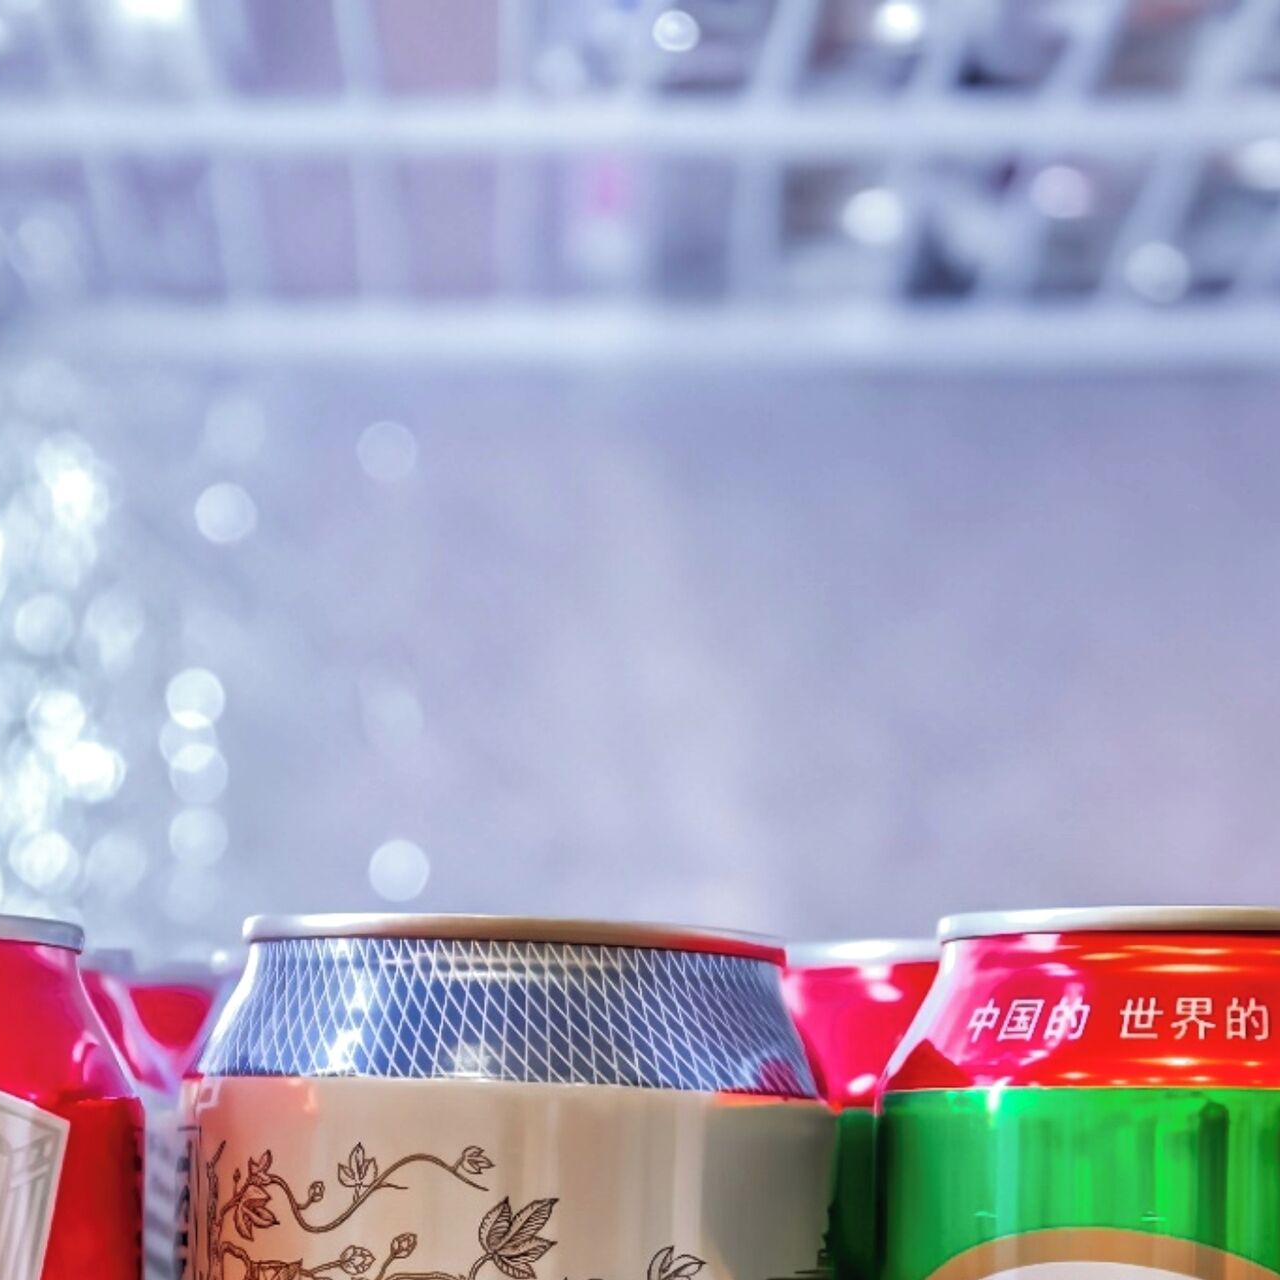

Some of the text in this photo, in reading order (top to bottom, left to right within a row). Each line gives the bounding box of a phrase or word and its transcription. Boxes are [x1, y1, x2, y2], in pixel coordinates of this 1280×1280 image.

[967, 997, 1269, 1042] 中国的 世界的
